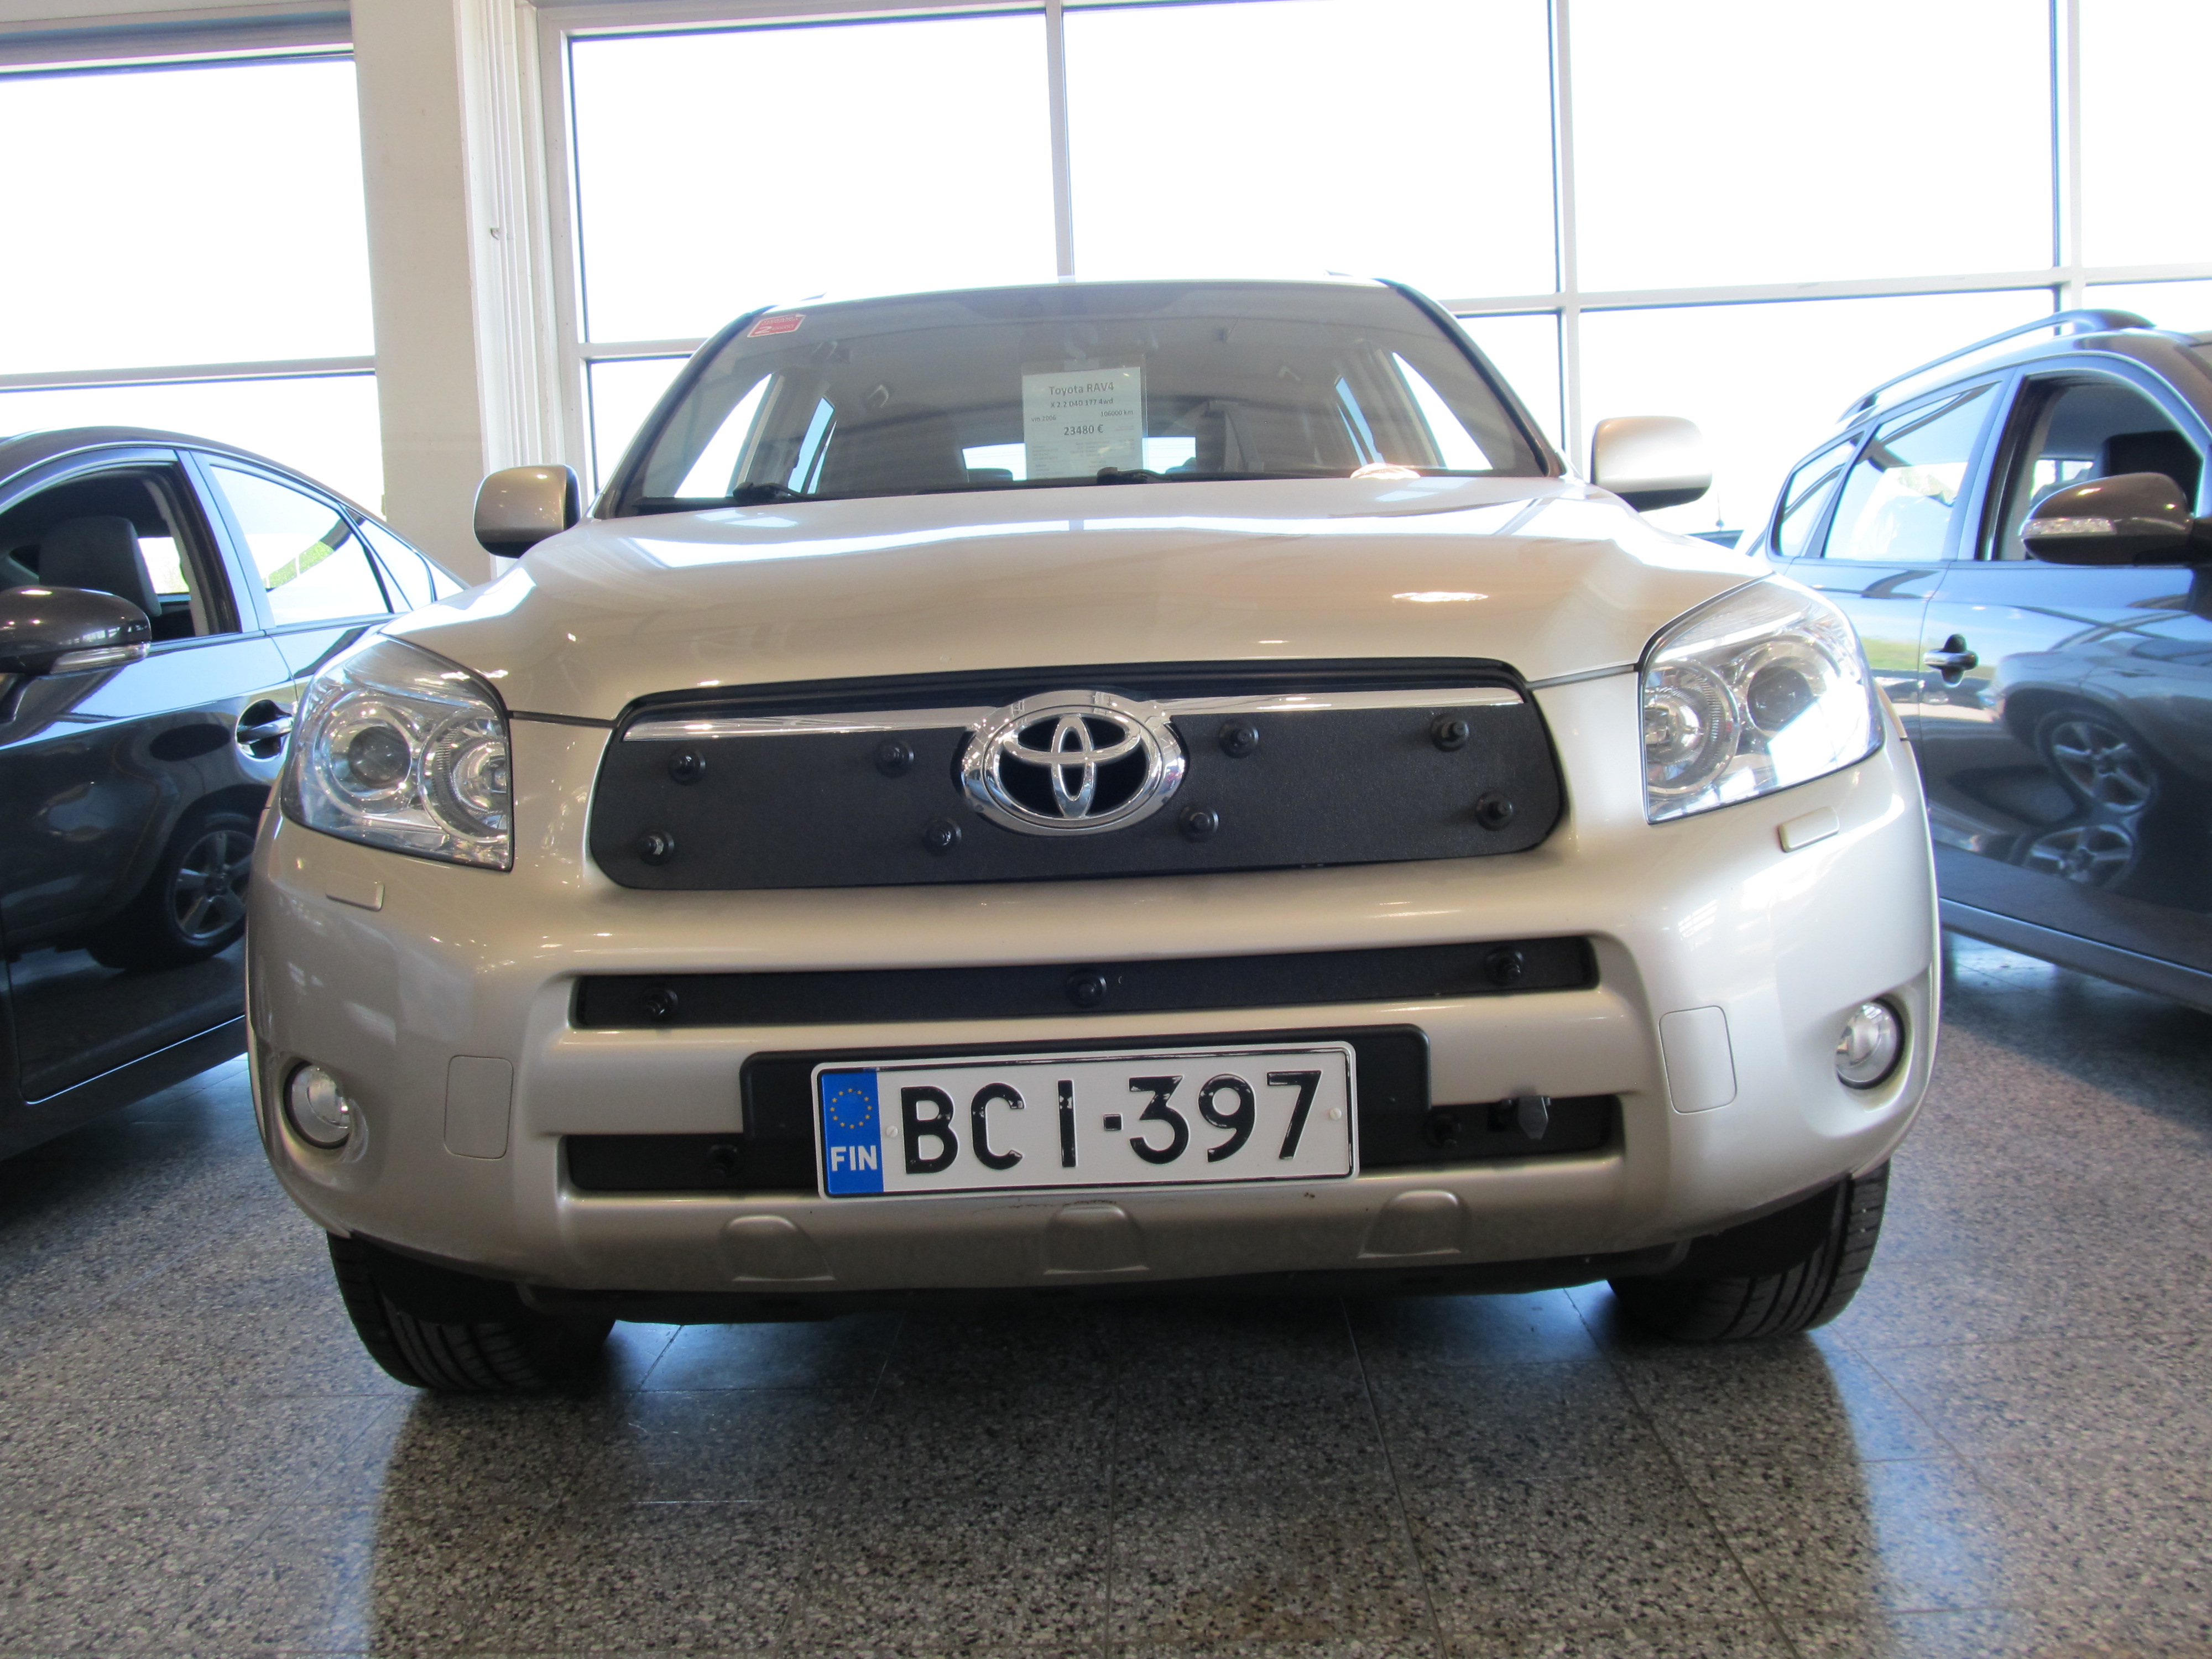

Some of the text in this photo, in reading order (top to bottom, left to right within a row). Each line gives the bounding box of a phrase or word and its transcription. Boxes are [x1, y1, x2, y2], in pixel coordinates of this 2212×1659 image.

[1049, 382, 1114, 396] Toyota RAV4
[1063, 425, 1094, 436] 23480
[1097, 424, 1104, 434] €
[831, 1145, 878, 1172] FIN
